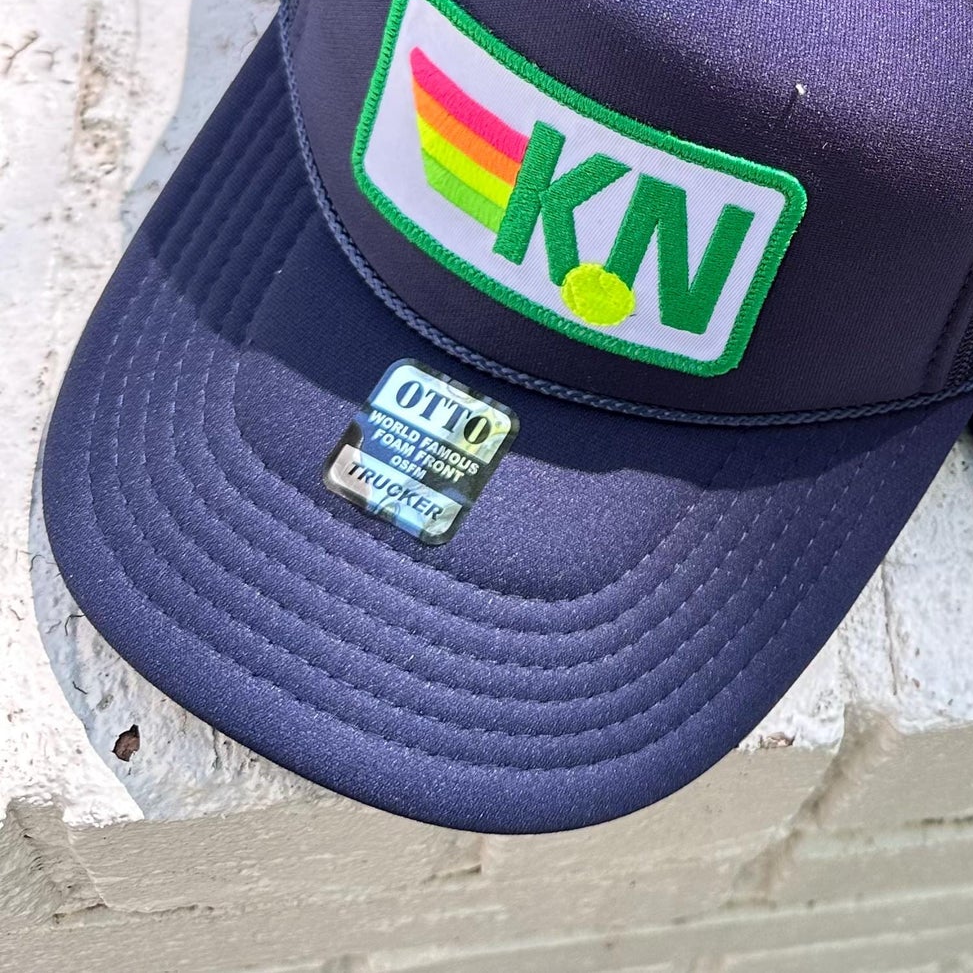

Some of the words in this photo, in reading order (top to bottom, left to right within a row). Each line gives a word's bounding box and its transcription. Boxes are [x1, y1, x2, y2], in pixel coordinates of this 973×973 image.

[492, 120, 755, 335] KN
[370, 410, 420, 442] WORLD
[420, 436, 480, 475] FAMOUS
[396, 380, 492, 445] OTTO
[372, 429, 414, 461] FOAM
[414, 451, 465, 483] FRONT
[391, 454, 427, 480] OSFM
[347, 462, 444, 521] TRUCKER
